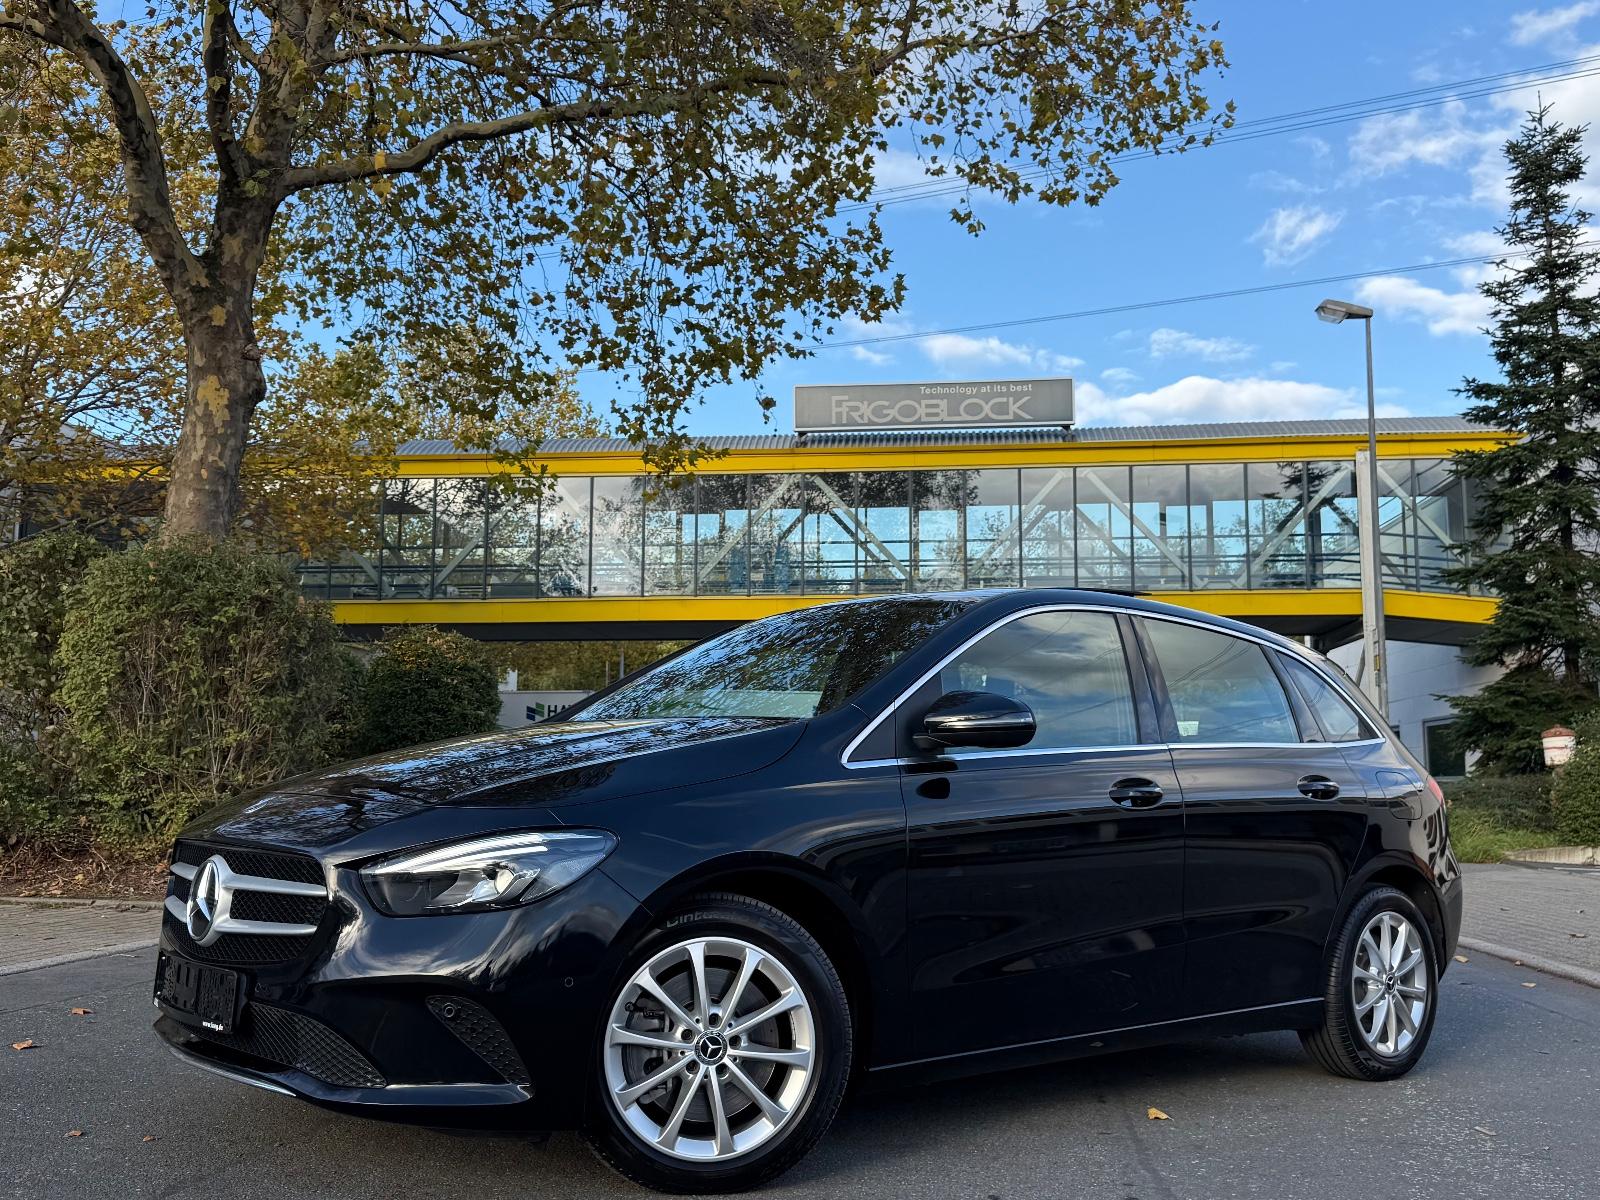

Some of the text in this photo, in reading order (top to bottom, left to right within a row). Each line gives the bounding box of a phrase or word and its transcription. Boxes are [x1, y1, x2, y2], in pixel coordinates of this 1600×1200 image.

[919, 383, 1032, 394] Technology at its best
[831, 395, 1033, 424] FRIGOBLOCK
